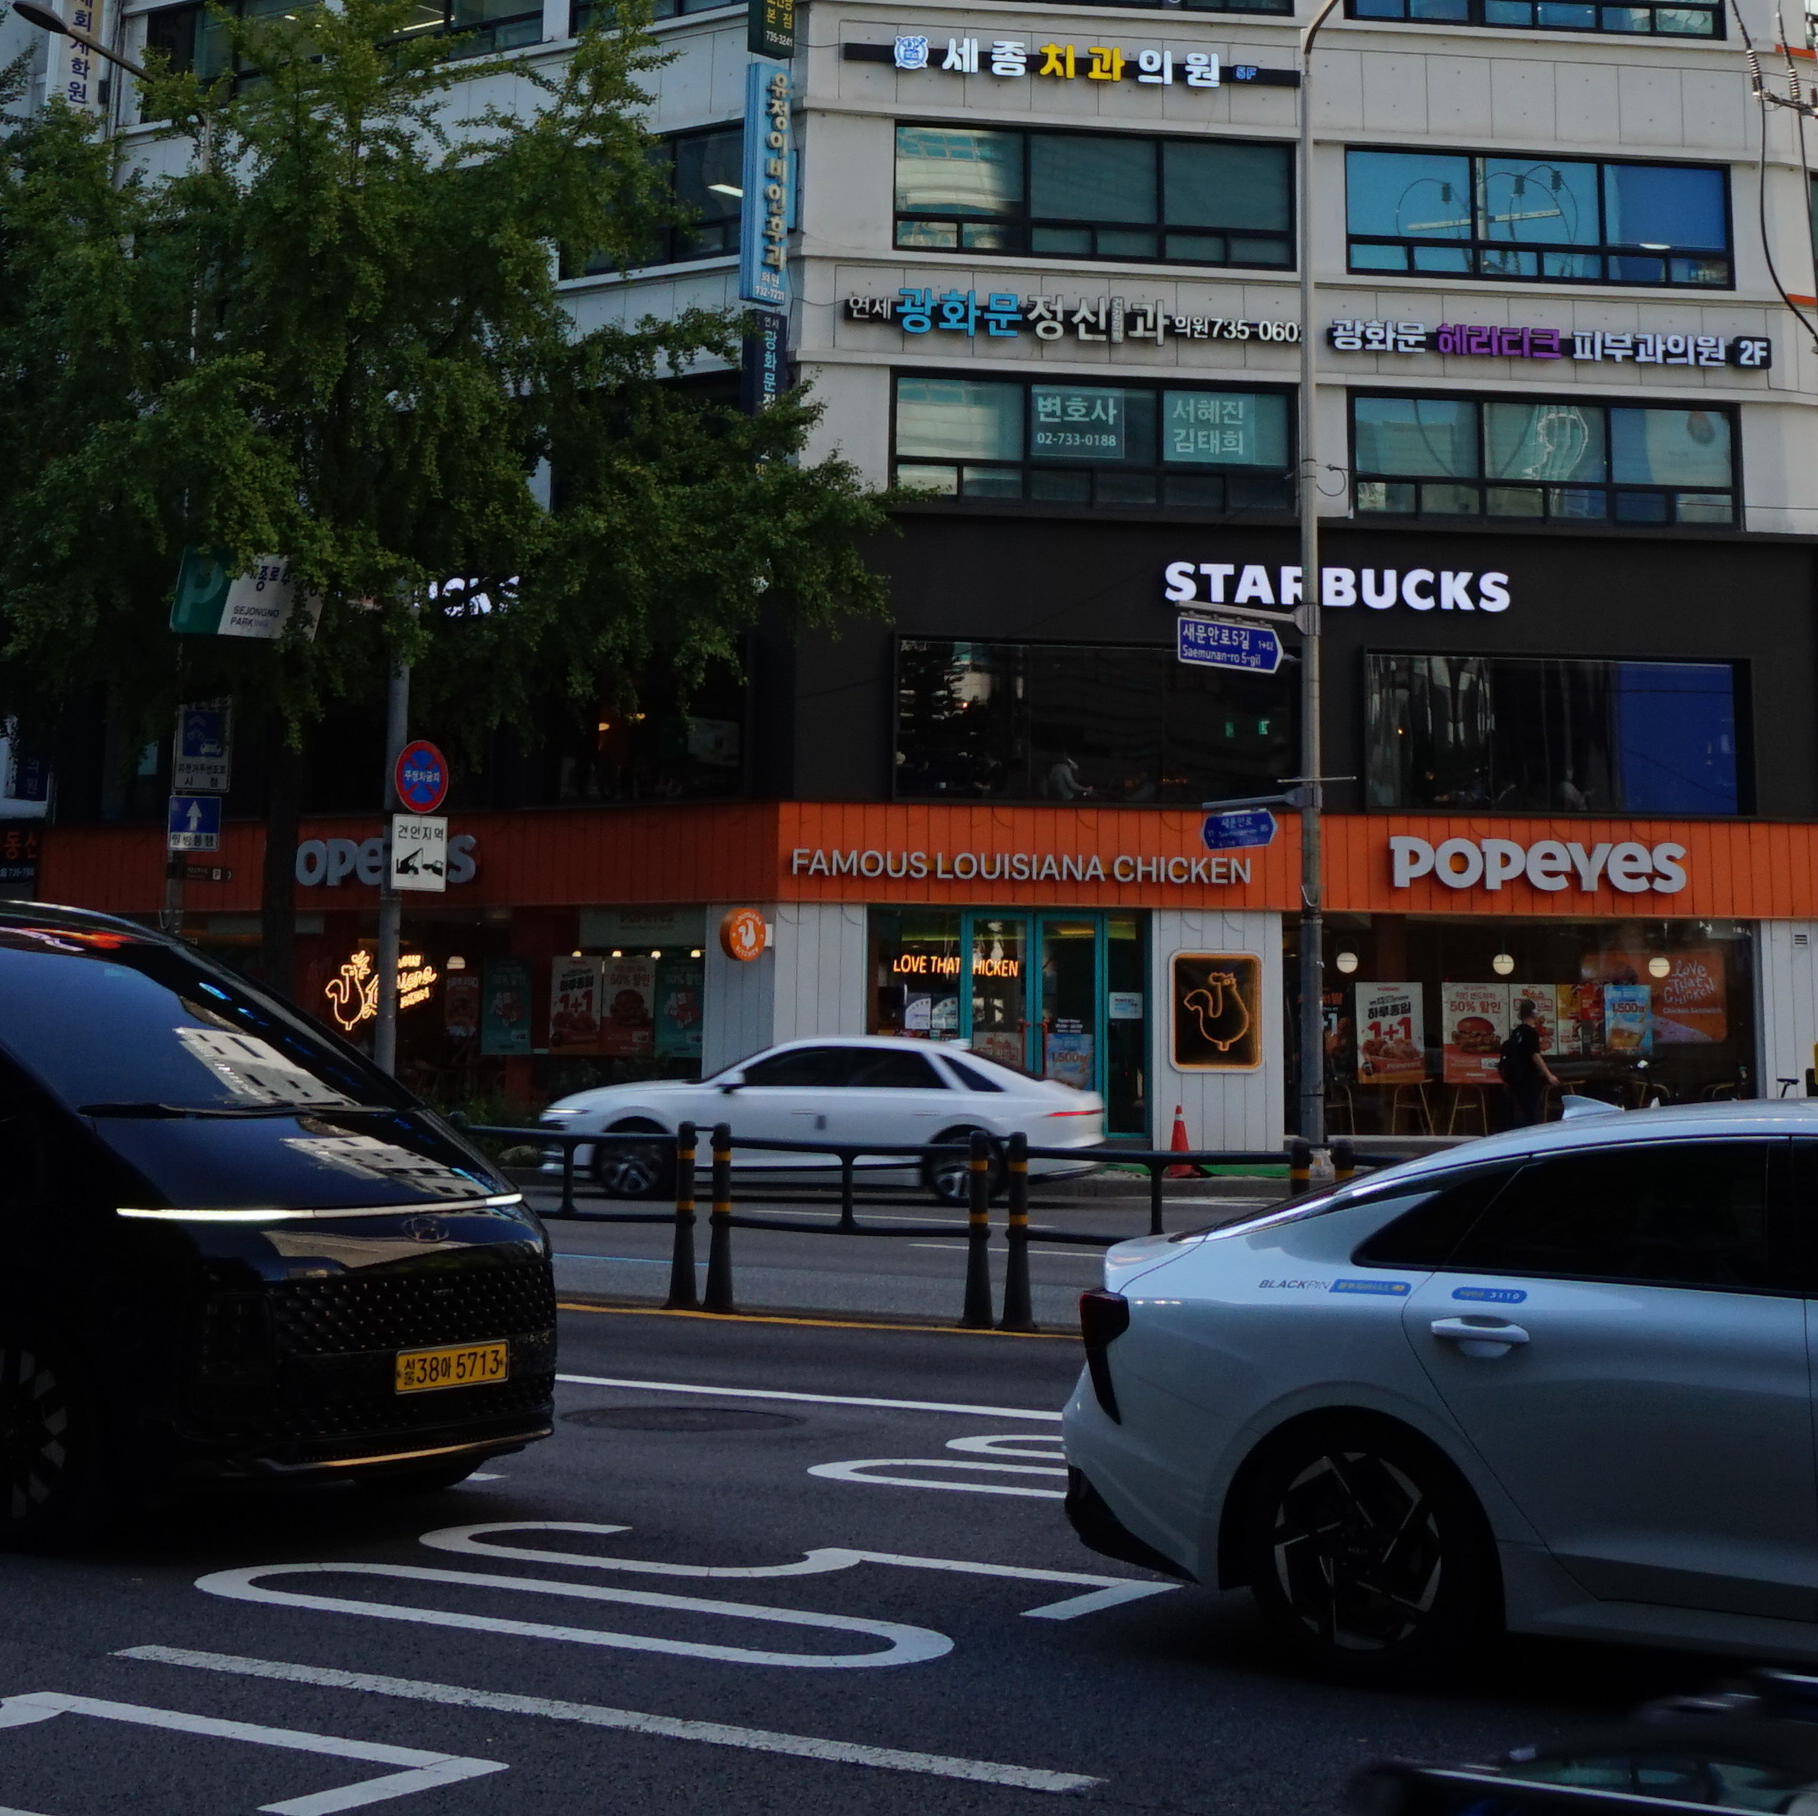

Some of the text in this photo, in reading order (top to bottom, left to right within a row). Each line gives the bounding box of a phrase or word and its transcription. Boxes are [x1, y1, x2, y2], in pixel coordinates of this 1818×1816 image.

[1210, 316, 1302, 344] 735-060
[1331, 318, 1768, 368] 광화문 헤리티크 피부과의원 2F
[1037, 396, 1118, 425] 변호사
[1173, 398, 1244, 425] 서혜진
[1037, 432, 1117, 447] 02-733-0188
[1173, 428, 1244, 455] 김태희
[1165, 561, 1511, 612] STARBUCKS
[1182, 622, 1250, 651] 새문안로5길
[1182, 644, 1240, 664] Saemunan-ro
[398, 824, 445, 841] 견인지역
[792, 848, 1252, 885] FAMOUS LOUISIANA CHICKEN
[892, 953, 1020, 979] LOVE THAT HICKEN
[560, 990, 594, 1014] 1+1
[1450, 1001, 1502, 1014] 50% 할인
[1367, 1016, 1412, 1042] 1+1
[456, 1349, 501, 1380] 5713
